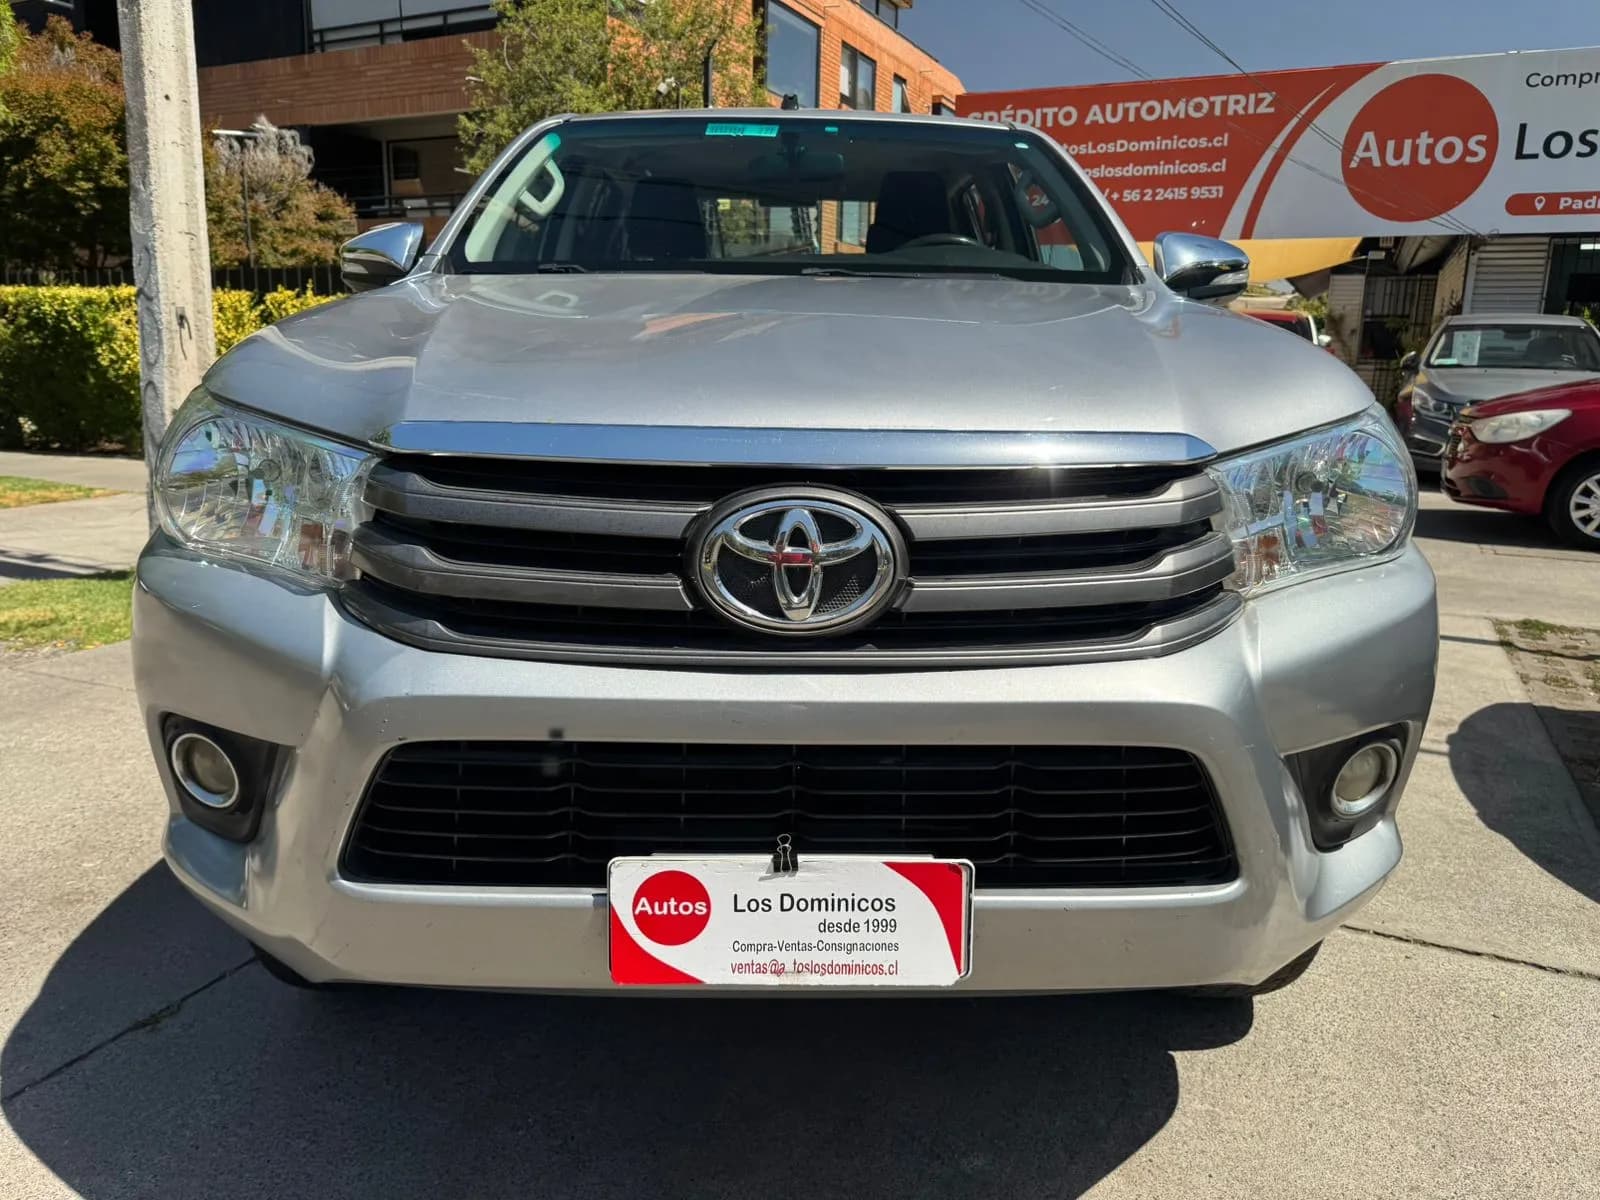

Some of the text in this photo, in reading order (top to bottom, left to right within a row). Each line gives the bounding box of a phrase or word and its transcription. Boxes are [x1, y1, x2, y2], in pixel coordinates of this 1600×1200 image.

[1084, 91, 1277, 125] AUTOMOTRIZ
[1349, 130, 1488, 169] Autos
[1515, 122, 1600, 160] Los
[1122, 188, 1141, 203] 56
[1143, 187, 1153, 201] 2
[1155, 186, 1188, 201] 2415
[1190, 184, 1224, 199] 9531
[634, 896, 707, 916] Autos
[733, 892, 896, 913] Los Dominicos
[818, 918, 898, 933] desde 1999
[732, 939, 900, 955] Compra-Ventas-Consignaciones
[730, 958, 899, 977] ventas@atoslosdominicos.cl
